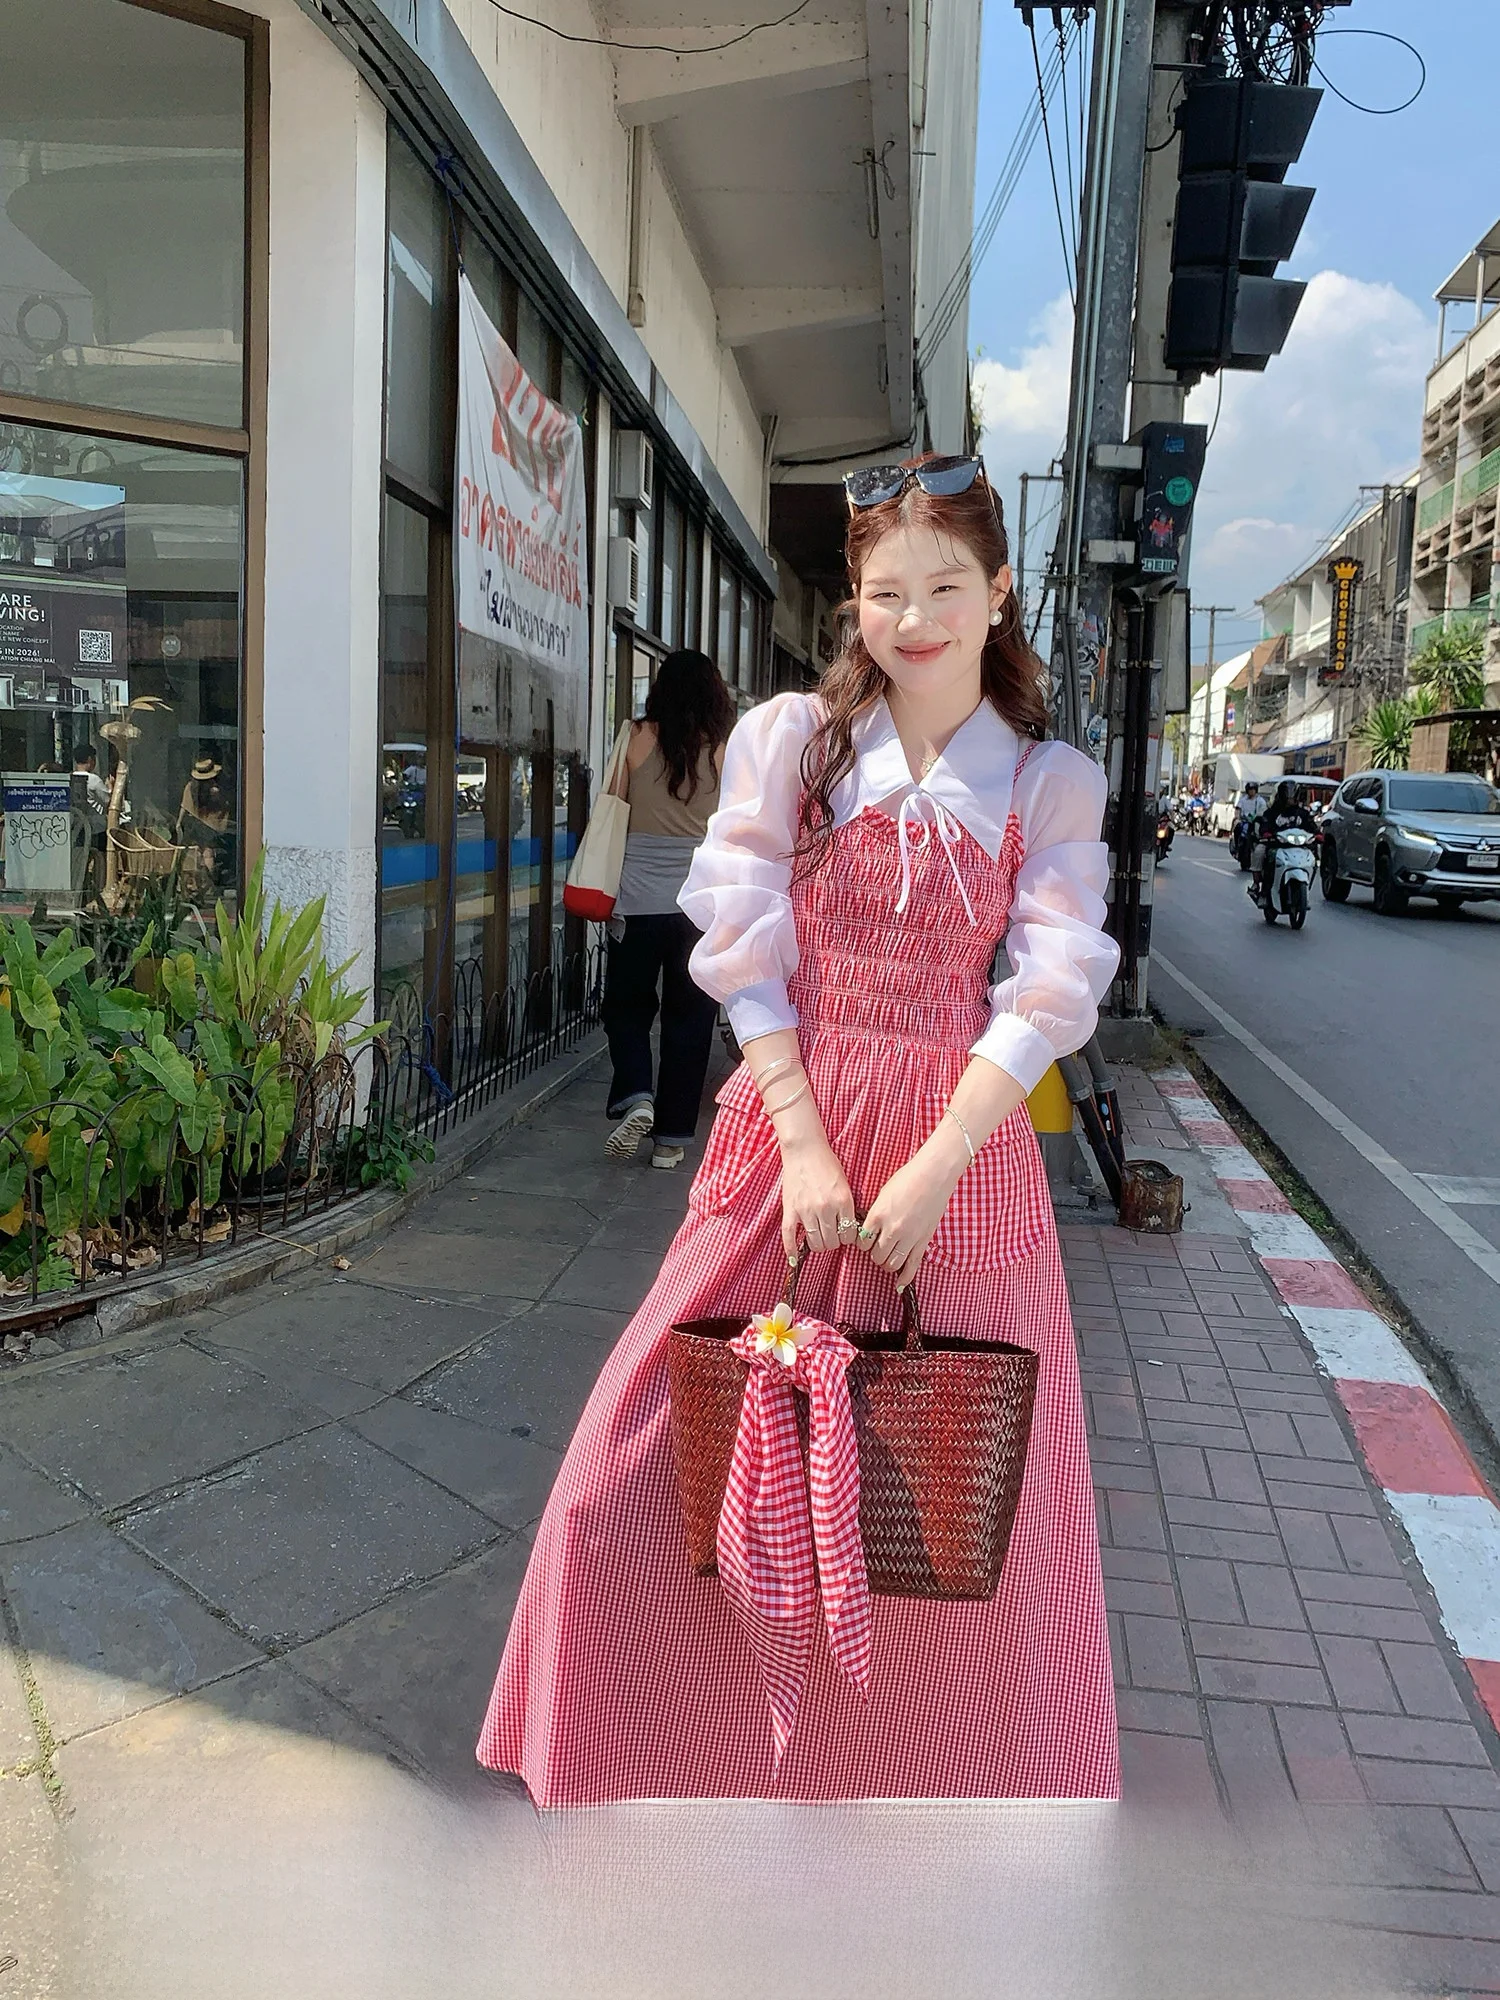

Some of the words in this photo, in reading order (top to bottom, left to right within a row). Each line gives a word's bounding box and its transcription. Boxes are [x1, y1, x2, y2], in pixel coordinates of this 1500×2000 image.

[0, 593, 32, 607] ARE
[1334, 579, 1350, 671] CROSSROAD
[17, 649, 40, 657] 2026!
